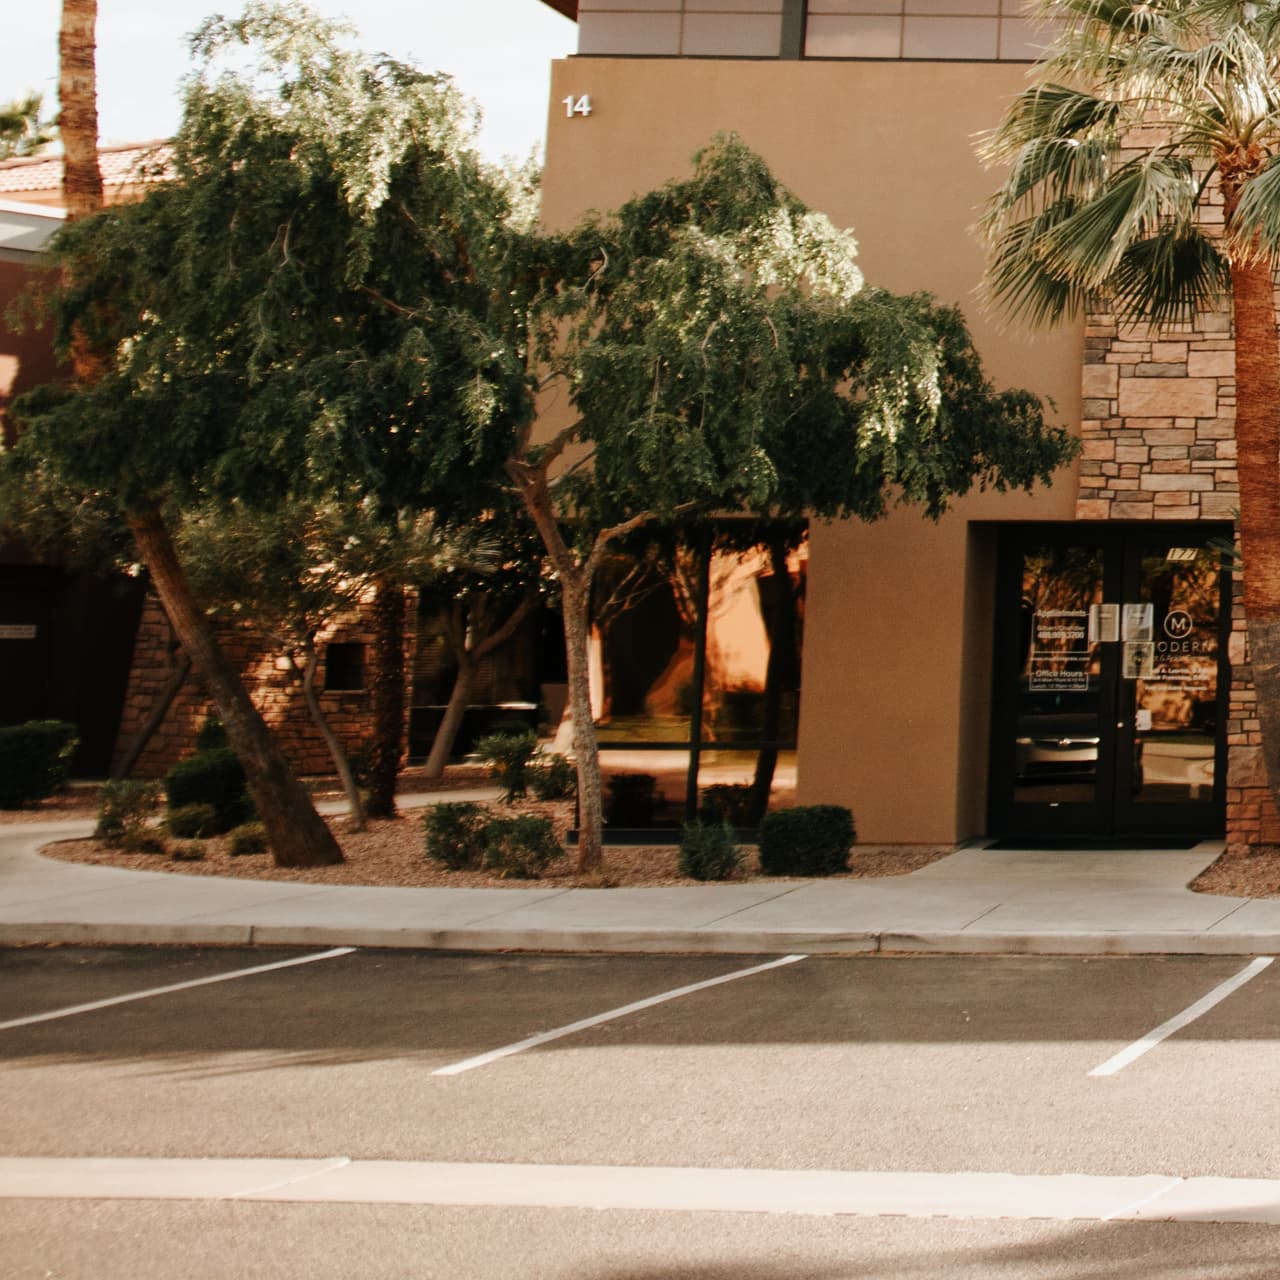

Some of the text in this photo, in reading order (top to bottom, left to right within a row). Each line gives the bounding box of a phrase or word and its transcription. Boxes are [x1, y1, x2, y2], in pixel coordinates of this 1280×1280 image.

[562, 94, 592, 118] 14
[1170, 617, 1186, 631] M
[1157, 641, 1211, 653] ODERN
[1035, 670, 1058, 678] Office
